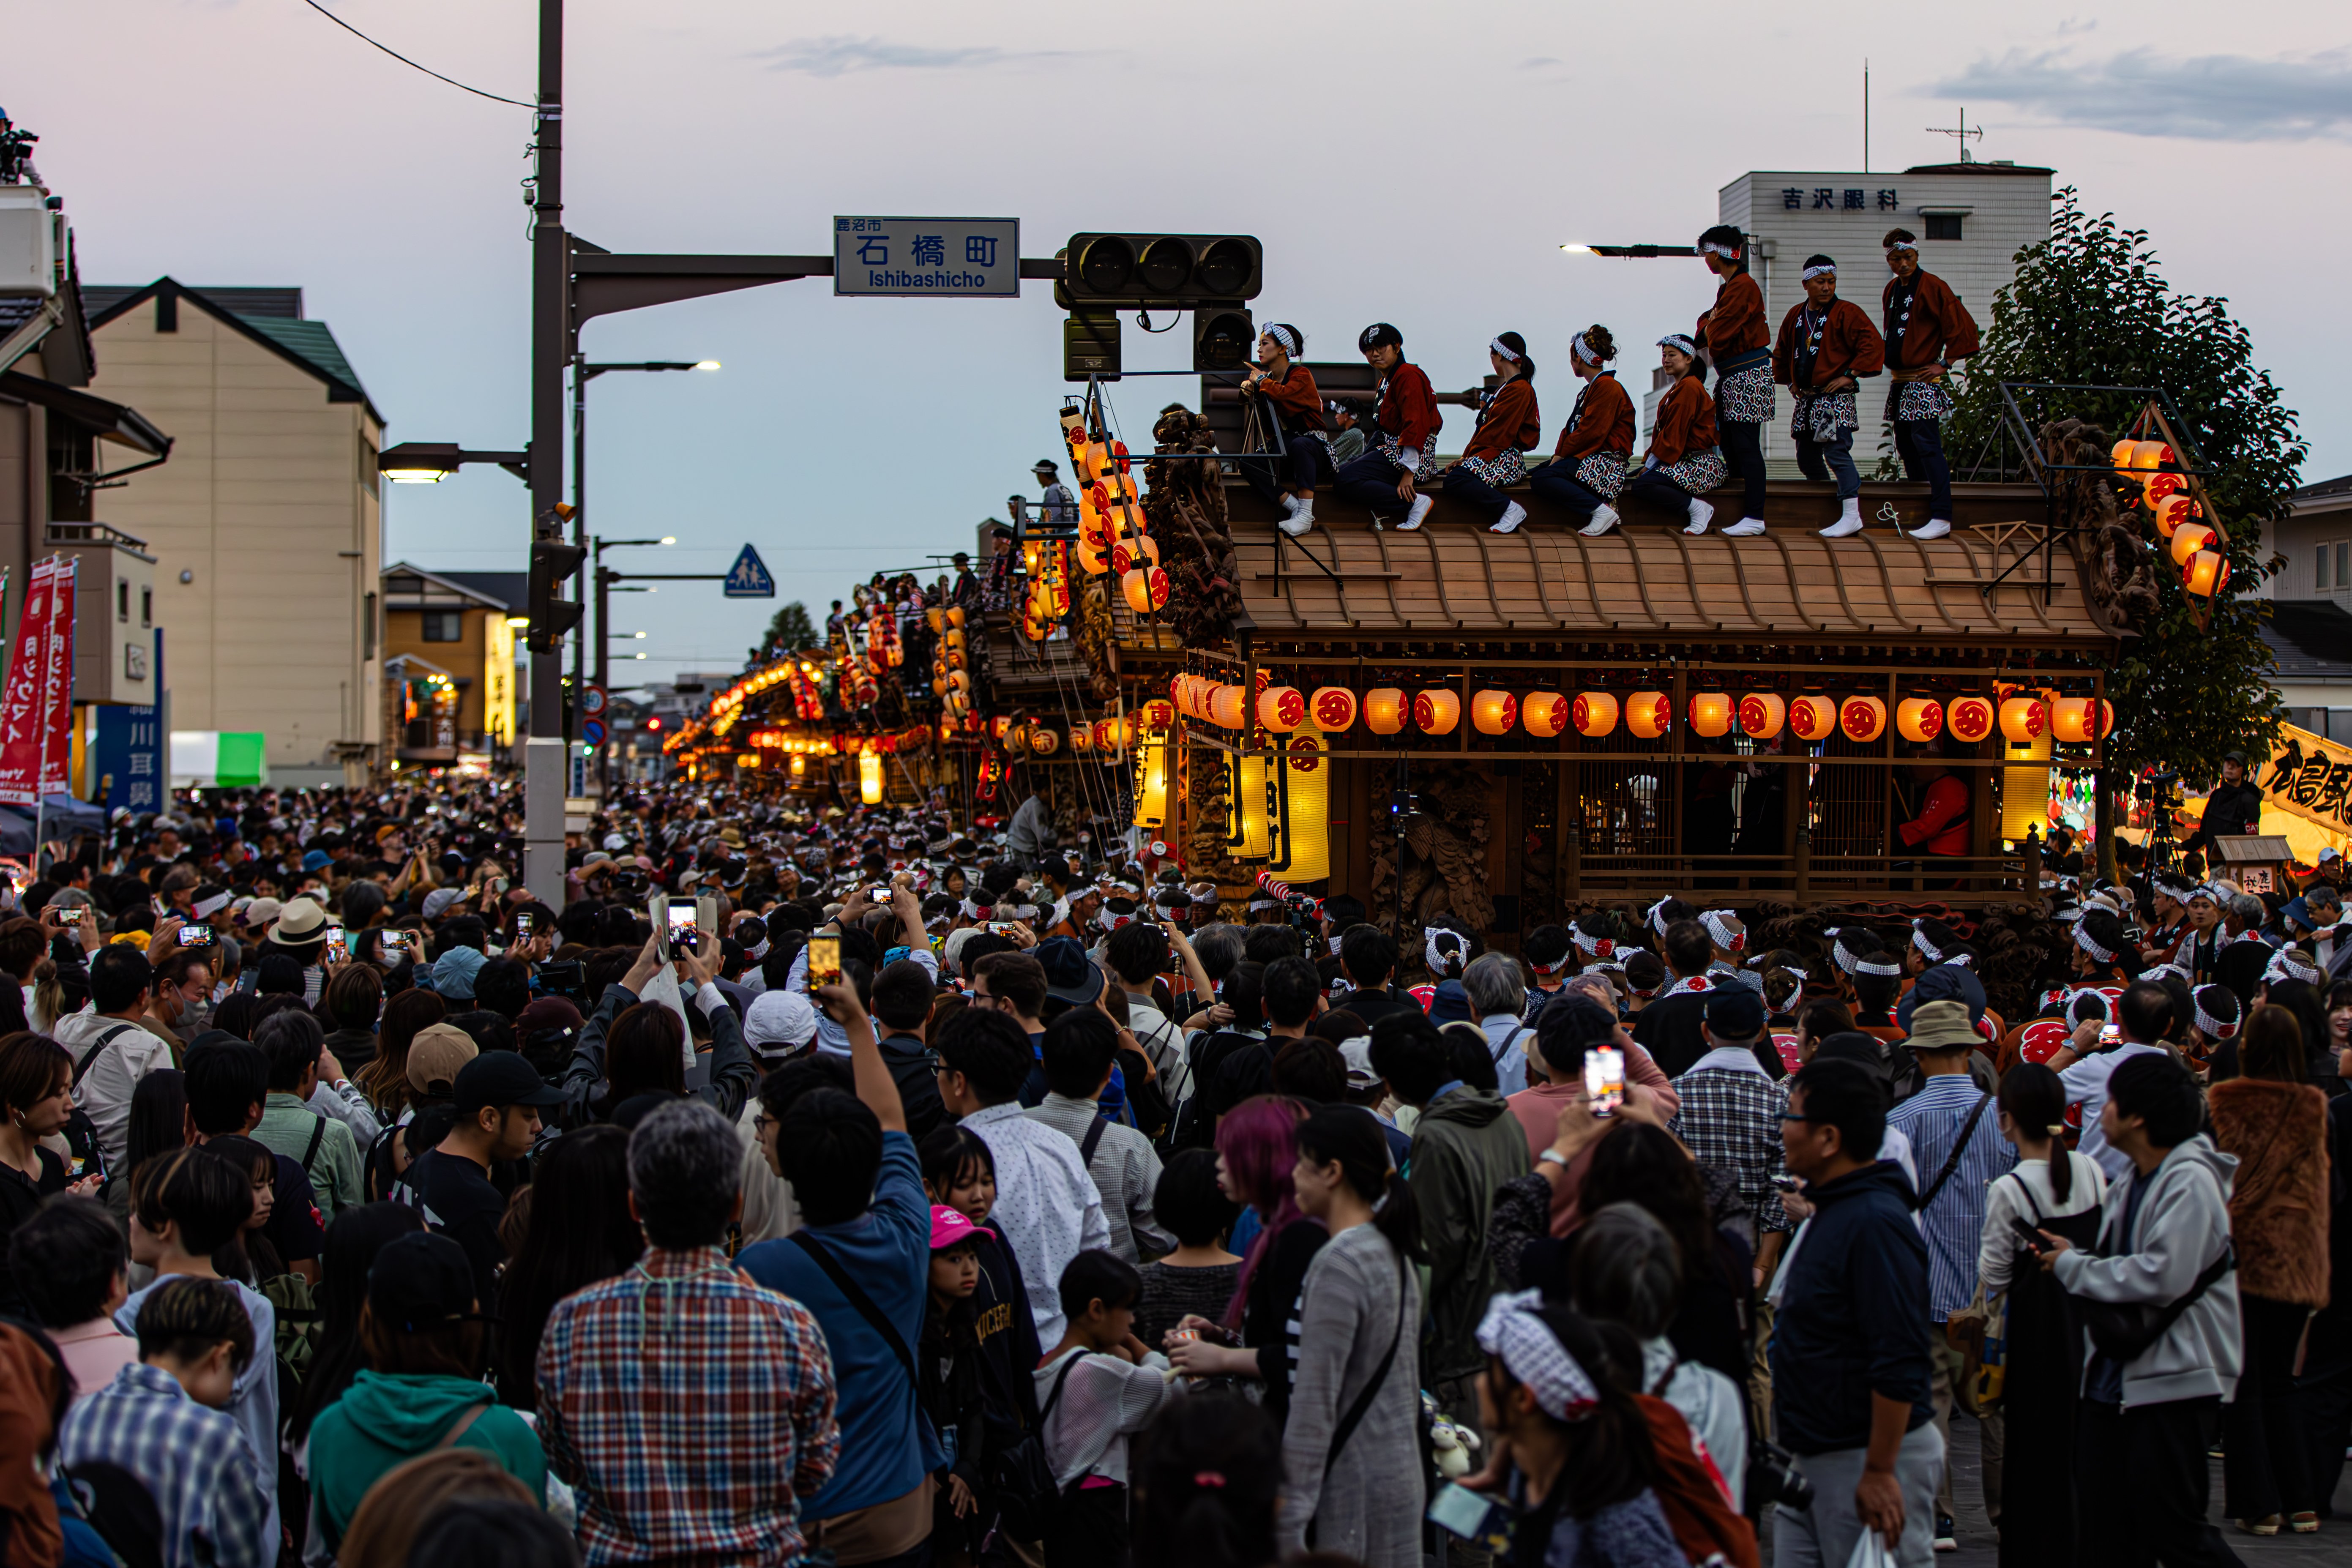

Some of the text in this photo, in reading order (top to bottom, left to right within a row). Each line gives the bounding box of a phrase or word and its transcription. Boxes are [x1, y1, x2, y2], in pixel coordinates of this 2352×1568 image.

[1782, 187, 1899, 210] 吉沢眼科
[836, 219, 881, 232] 鹿沼市
[856, 234, 998, 267] 石橋町
[869, 270, 985, 287] Ishibashicho
[1148, 702, 1172, 731] 東
